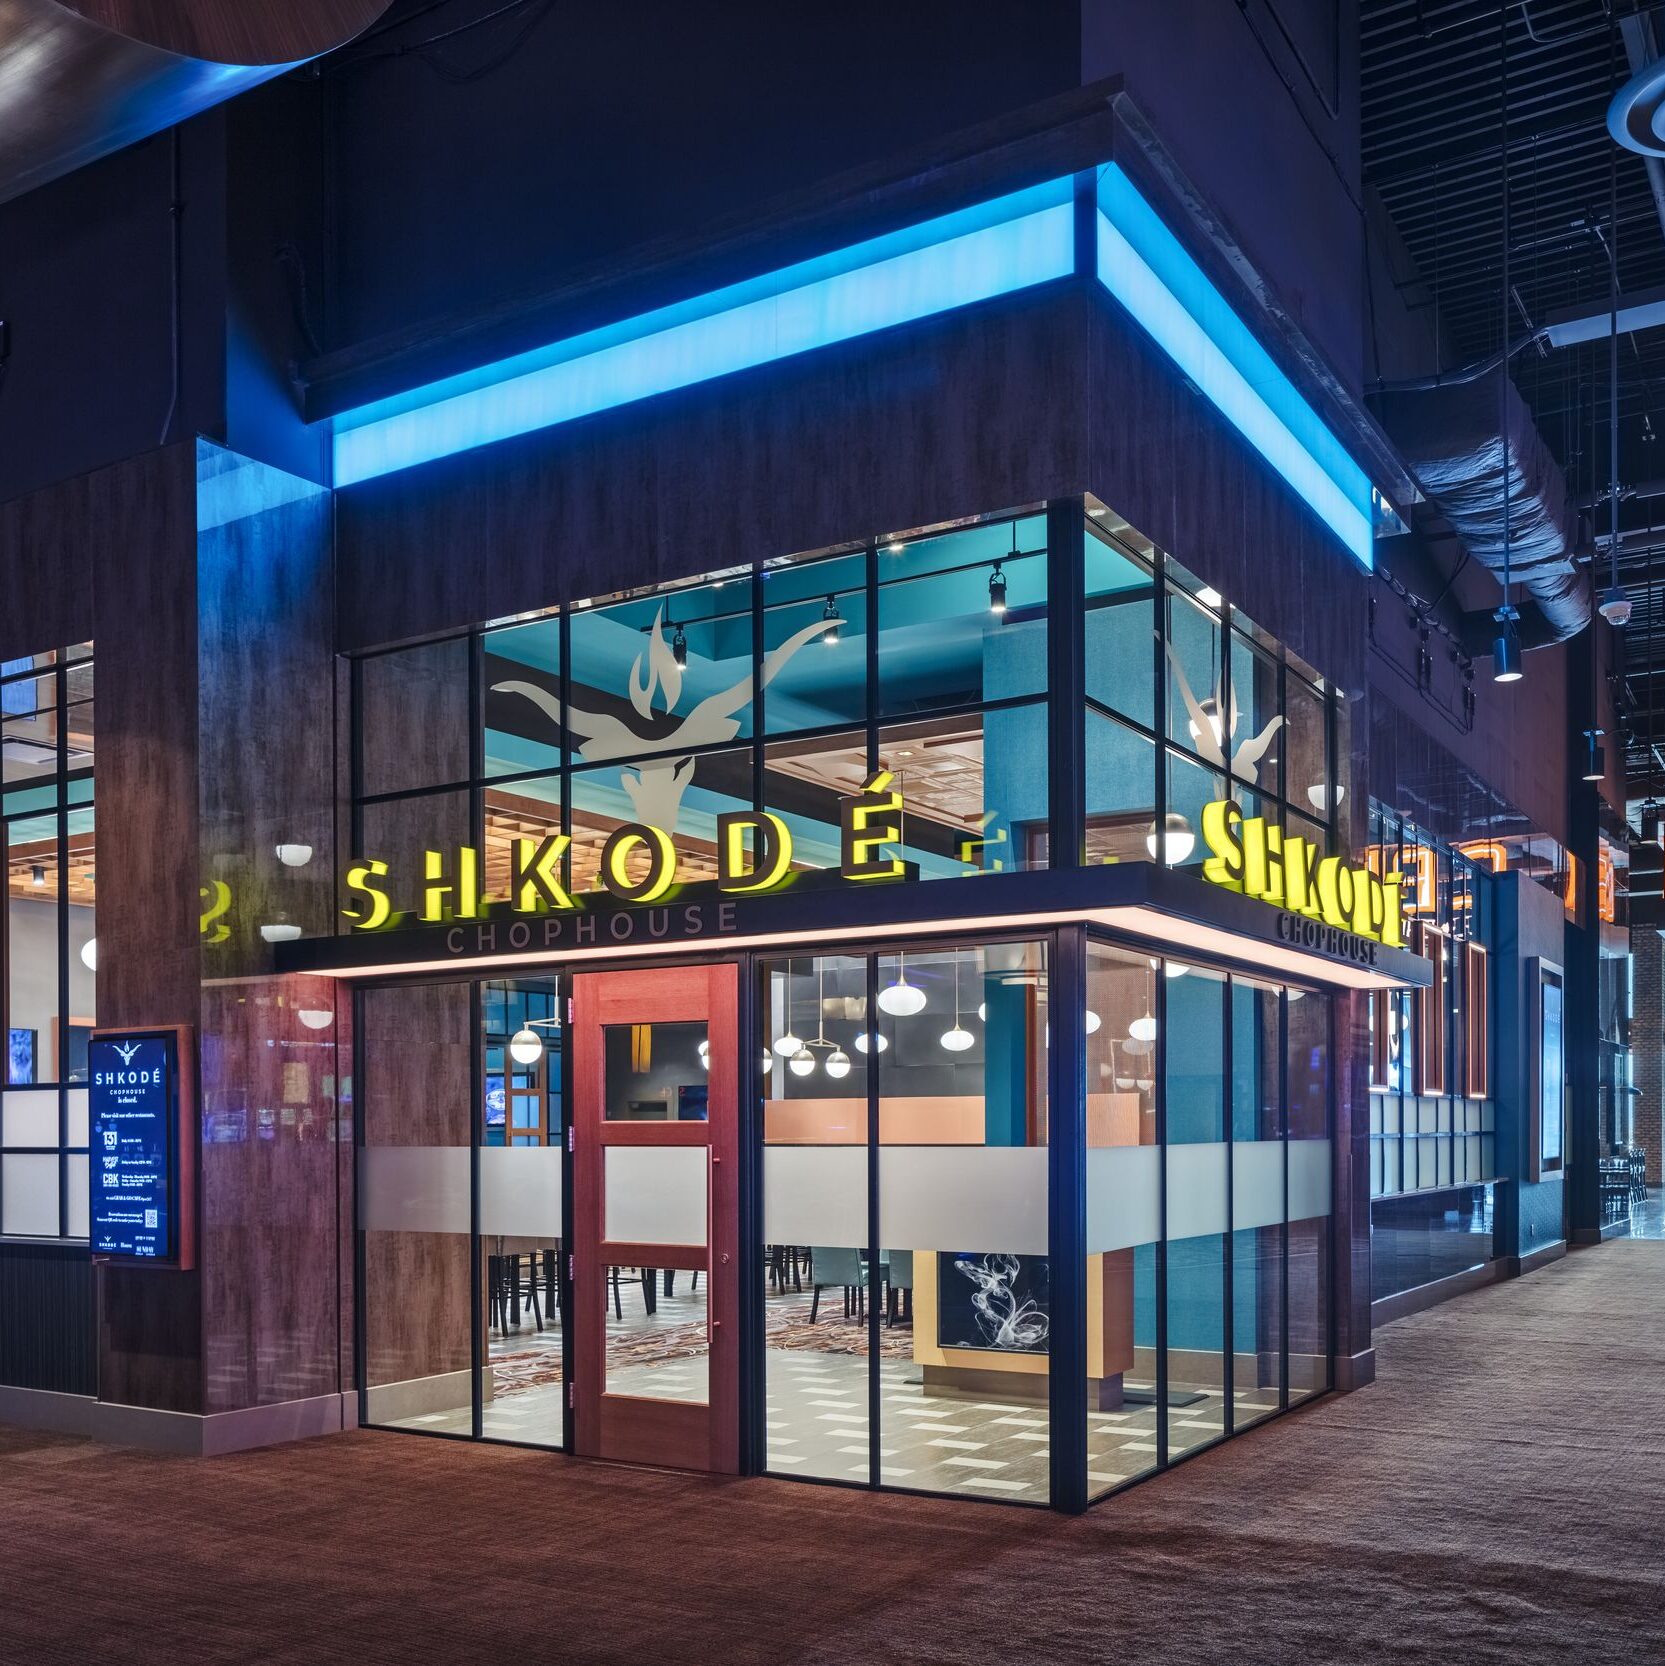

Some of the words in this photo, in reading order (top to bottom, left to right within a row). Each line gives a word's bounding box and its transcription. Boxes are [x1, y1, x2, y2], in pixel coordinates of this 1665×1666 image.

[341, 771, 905, 929] SHKODÉ
[446, 902, 737, 954] CHOPHOUSE
[1276, 912, 1378, 966] CHOPHOUSE
[95, 1068, 160, 1085] SHKODÉ
[103, 1131, 118, 1145] 131
[103, 1173, 119, 1184] CBK
